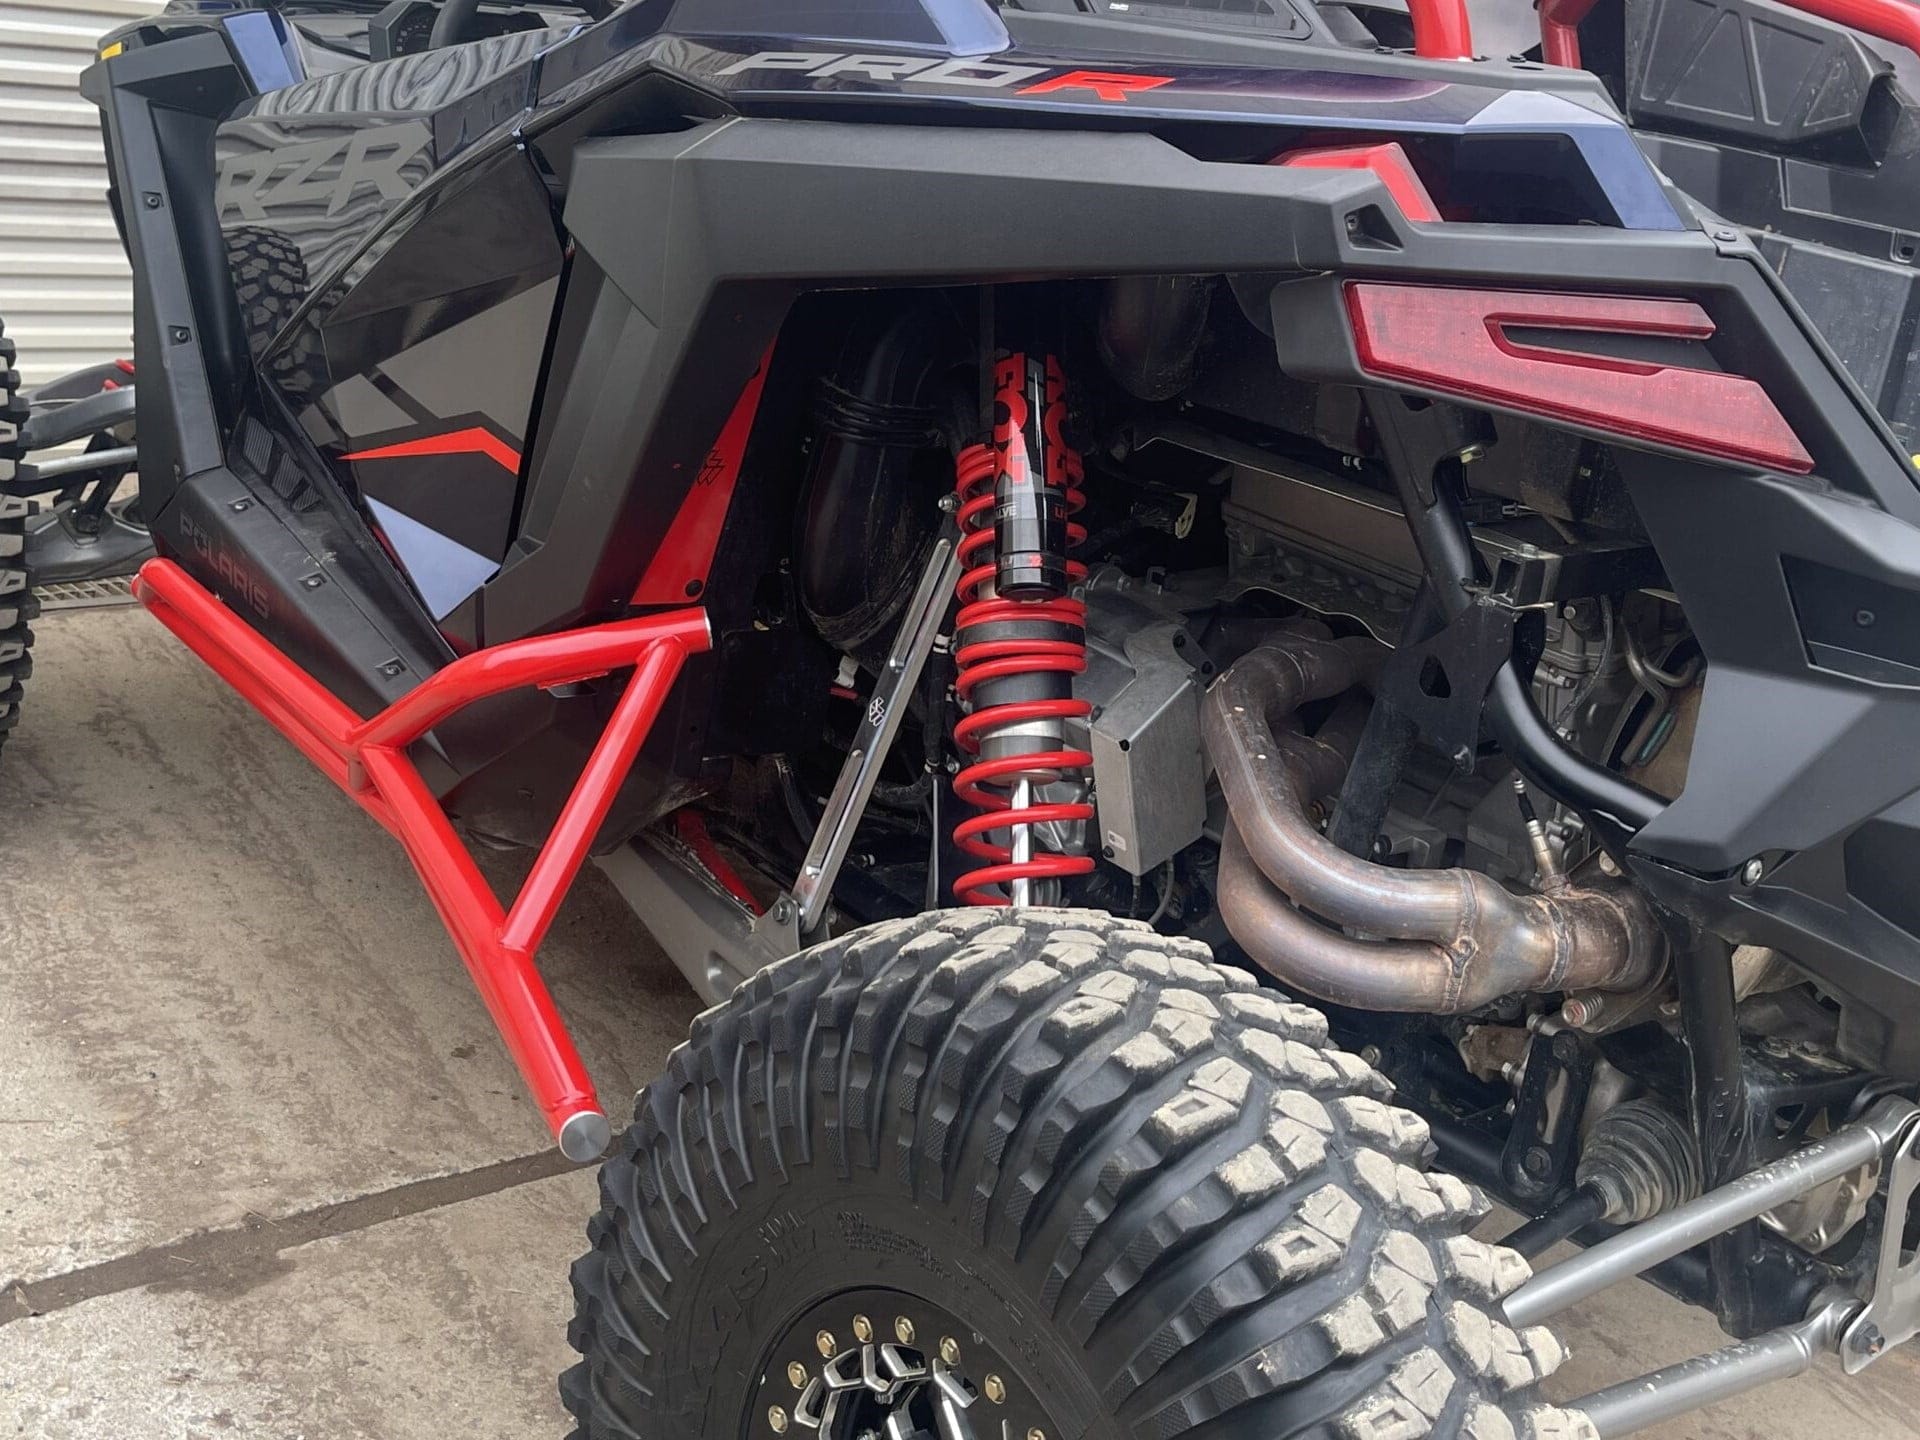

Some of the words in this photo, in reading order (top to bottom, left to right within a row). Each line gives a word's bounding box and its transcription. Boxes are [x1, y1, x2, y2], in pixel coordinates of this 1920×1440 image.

[714, 51, 1051, 88] PRO
[1014, 70, 1177, 102] R
[215, 119, 434, 220] RZR
[179, 511, 270, 620] POLARIS
